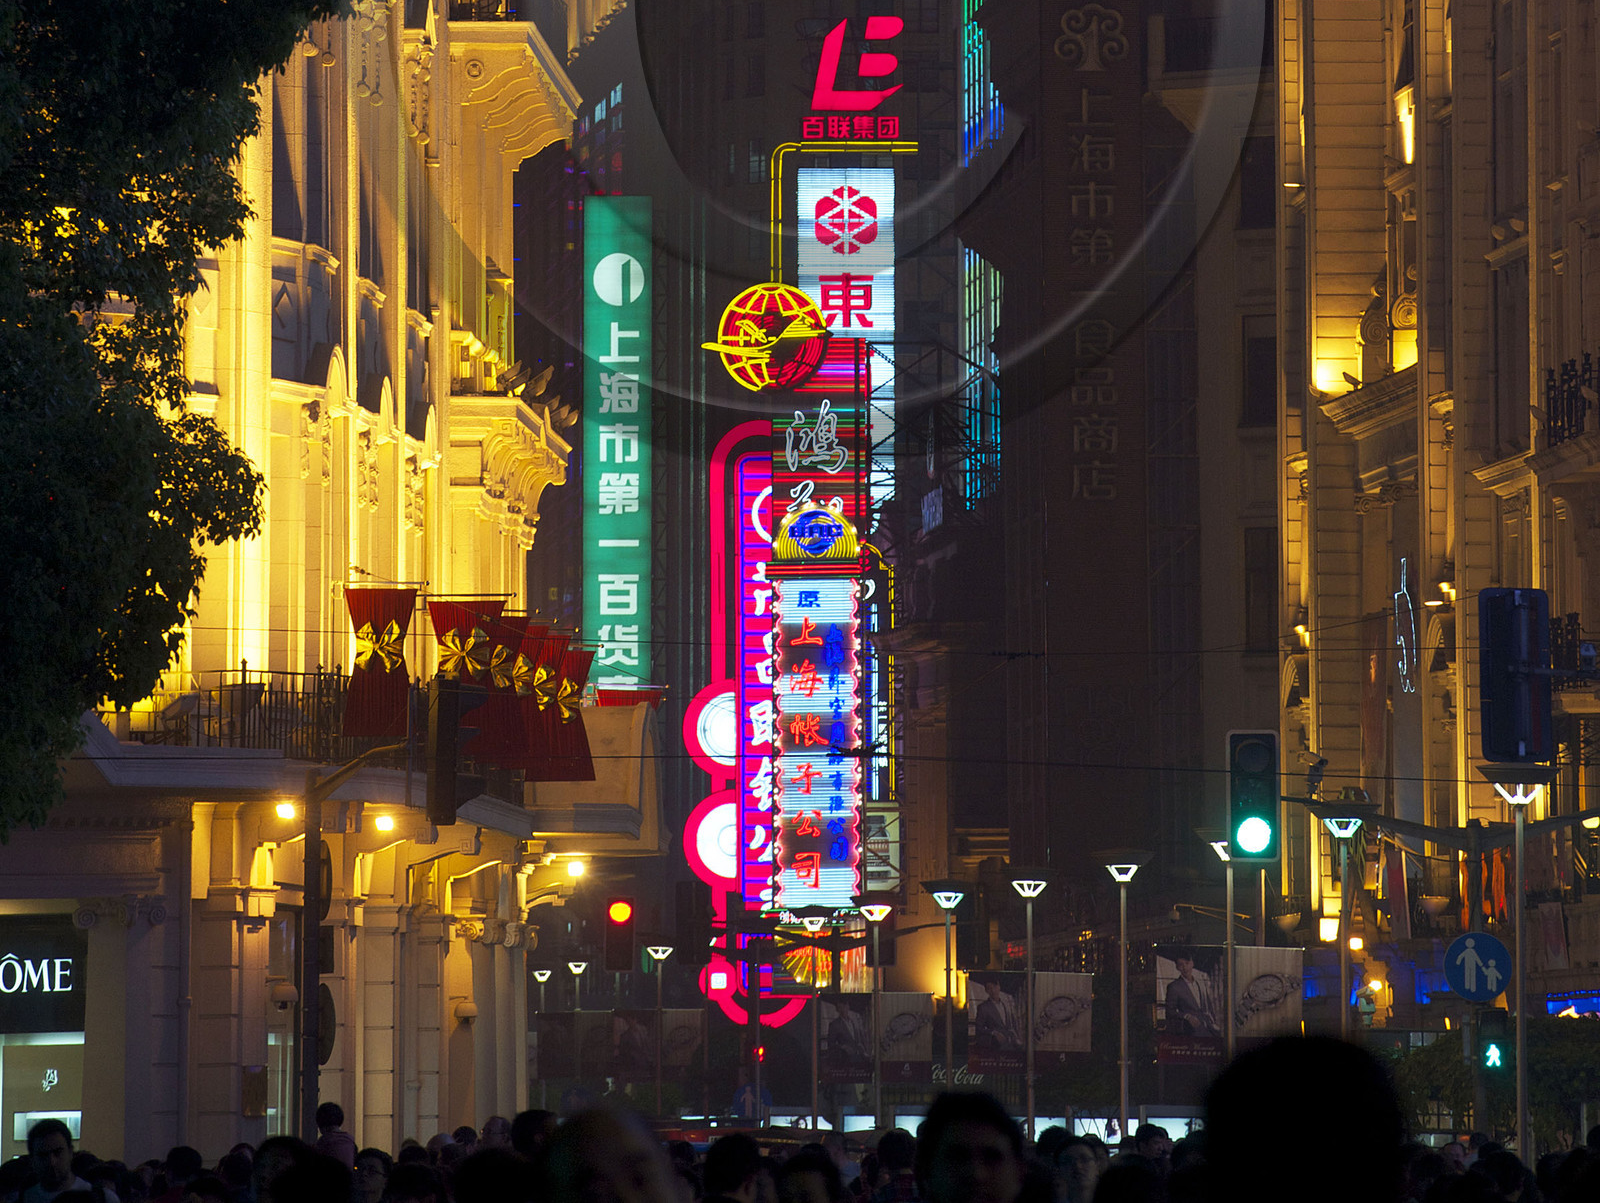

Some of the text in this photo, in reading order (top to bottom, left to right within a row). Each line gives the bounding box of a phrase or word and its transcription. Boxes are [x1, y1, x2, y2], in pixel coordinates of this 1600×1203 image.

[802, 116, 899, 139] 百联集团
[818, 272, 874, 328] 東
